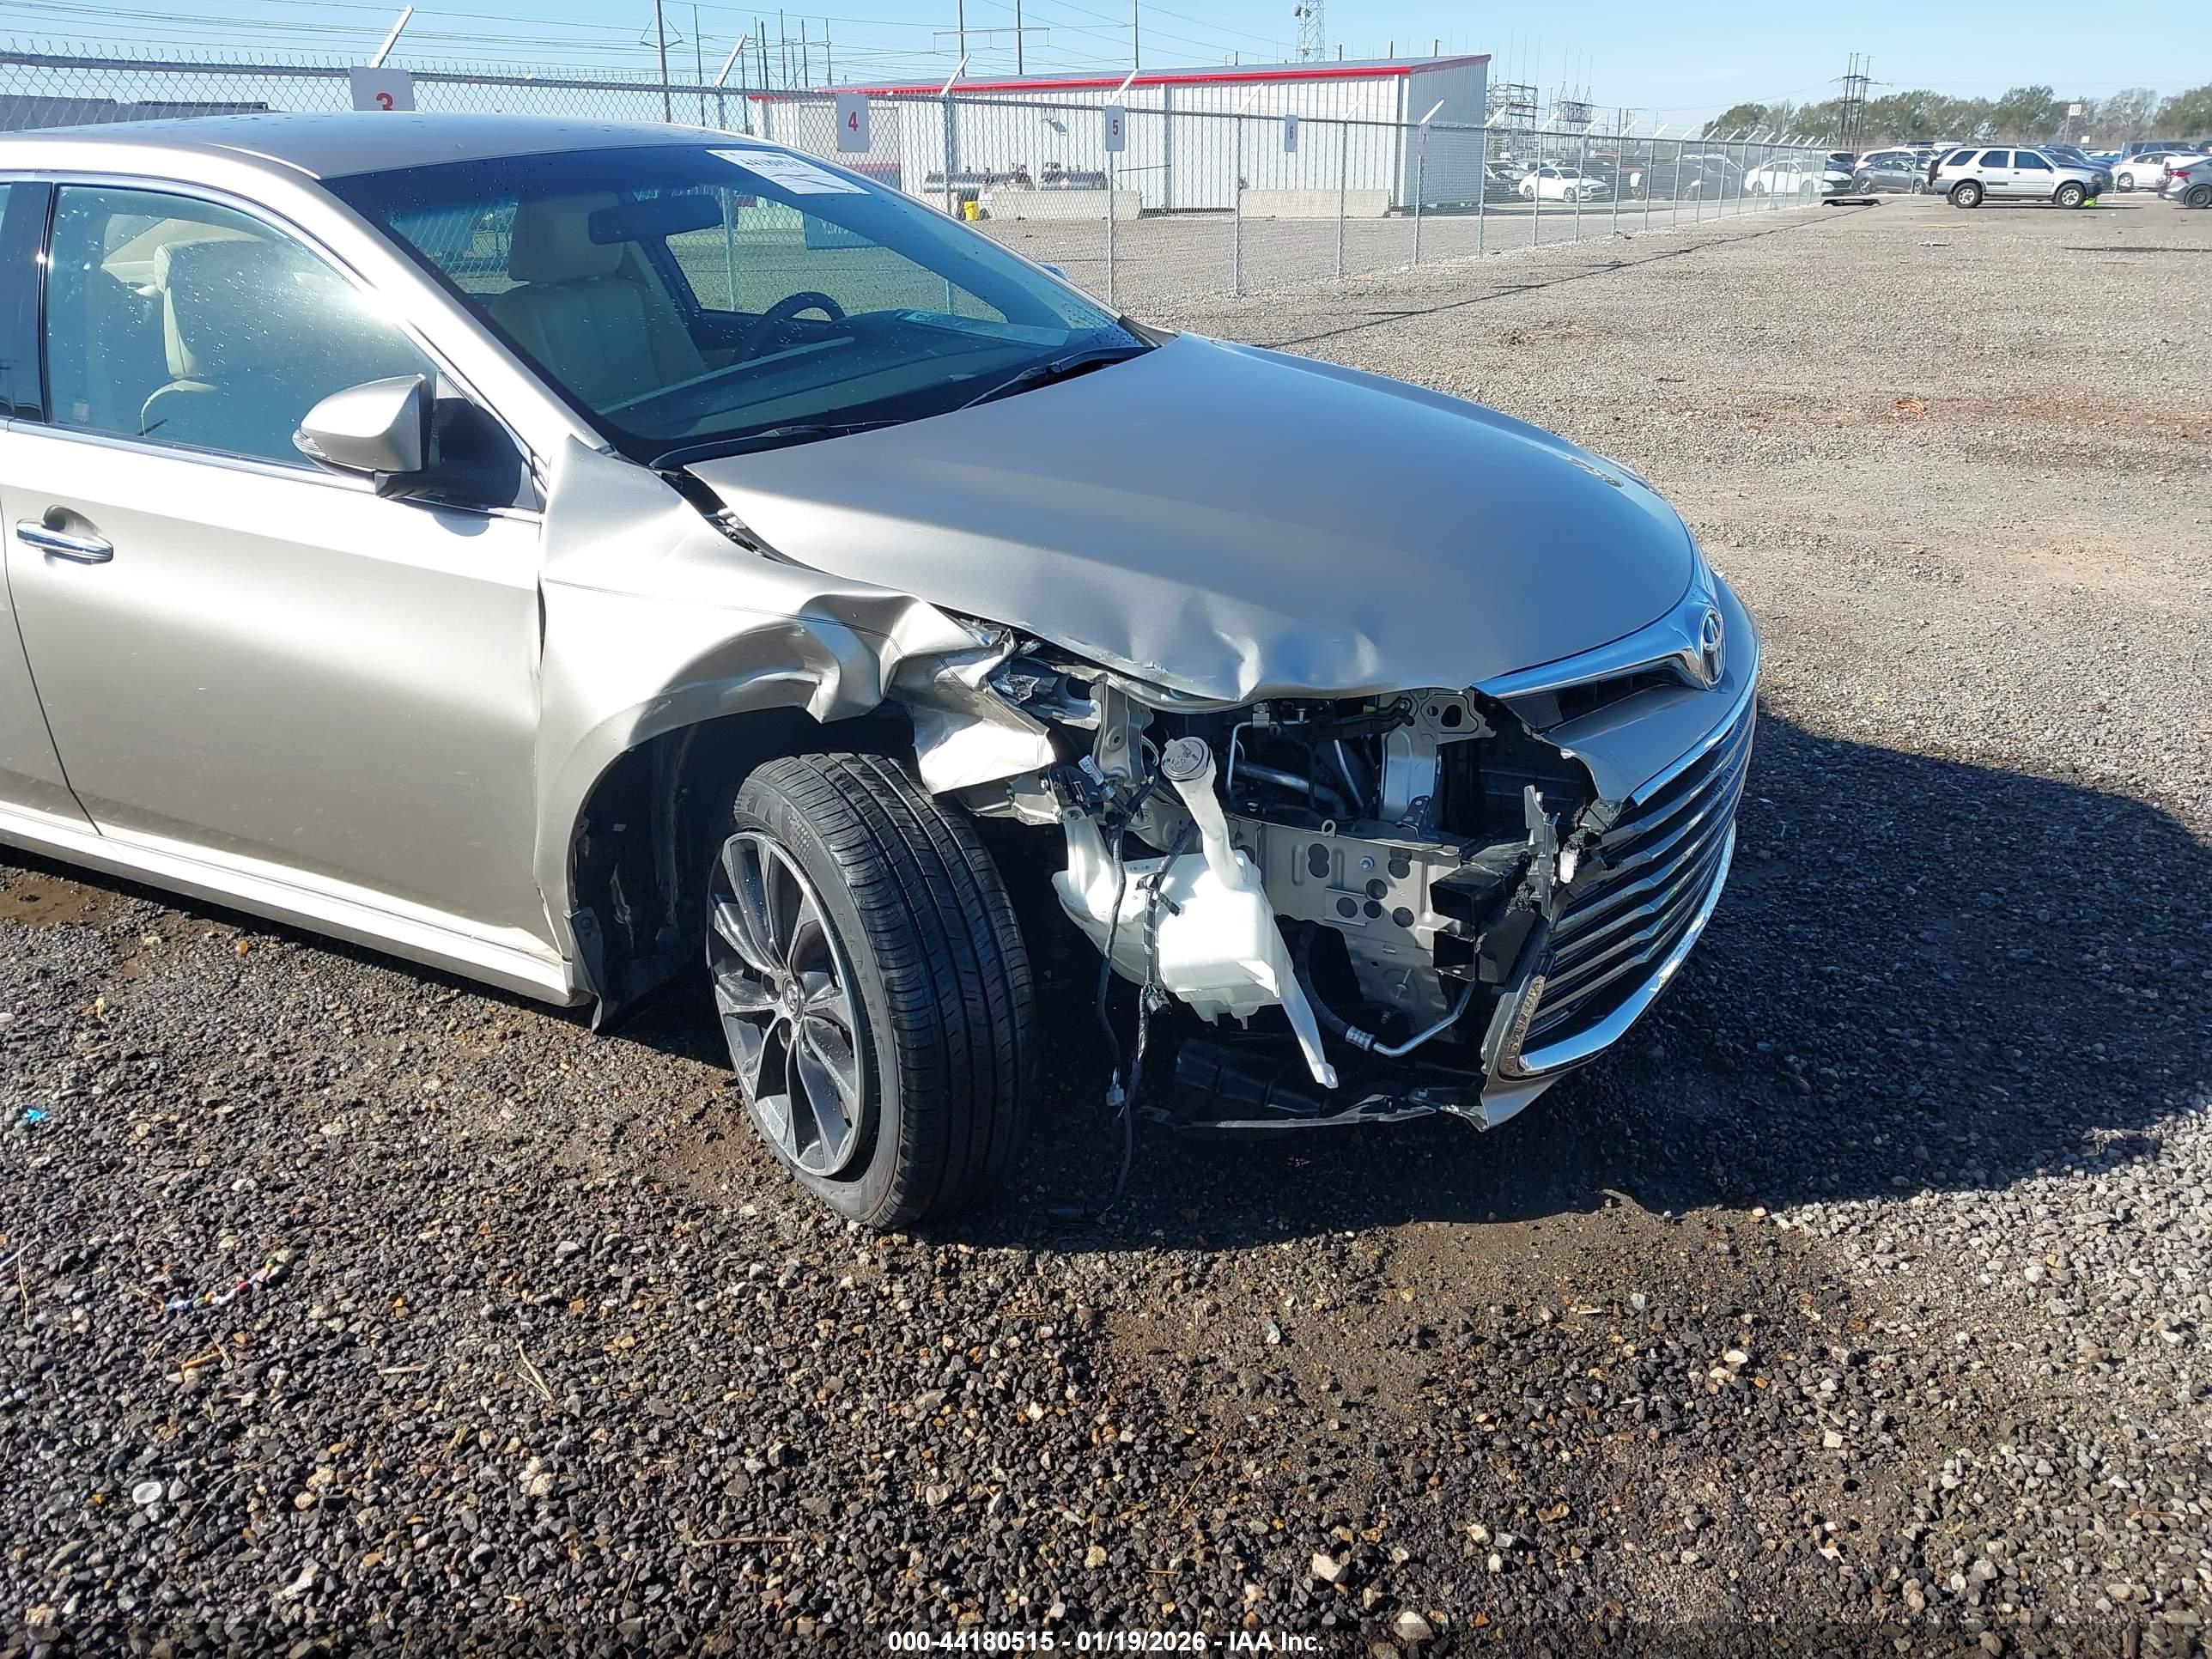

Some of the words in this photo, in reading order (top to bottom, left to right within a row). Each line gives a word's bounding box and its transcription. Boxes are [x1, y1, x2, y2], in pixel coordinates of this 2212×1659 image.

[848, 111, 859, 131] 4
[1112, 118, 1119, 136] 5
[1289, 125, 1294, 139] 6
